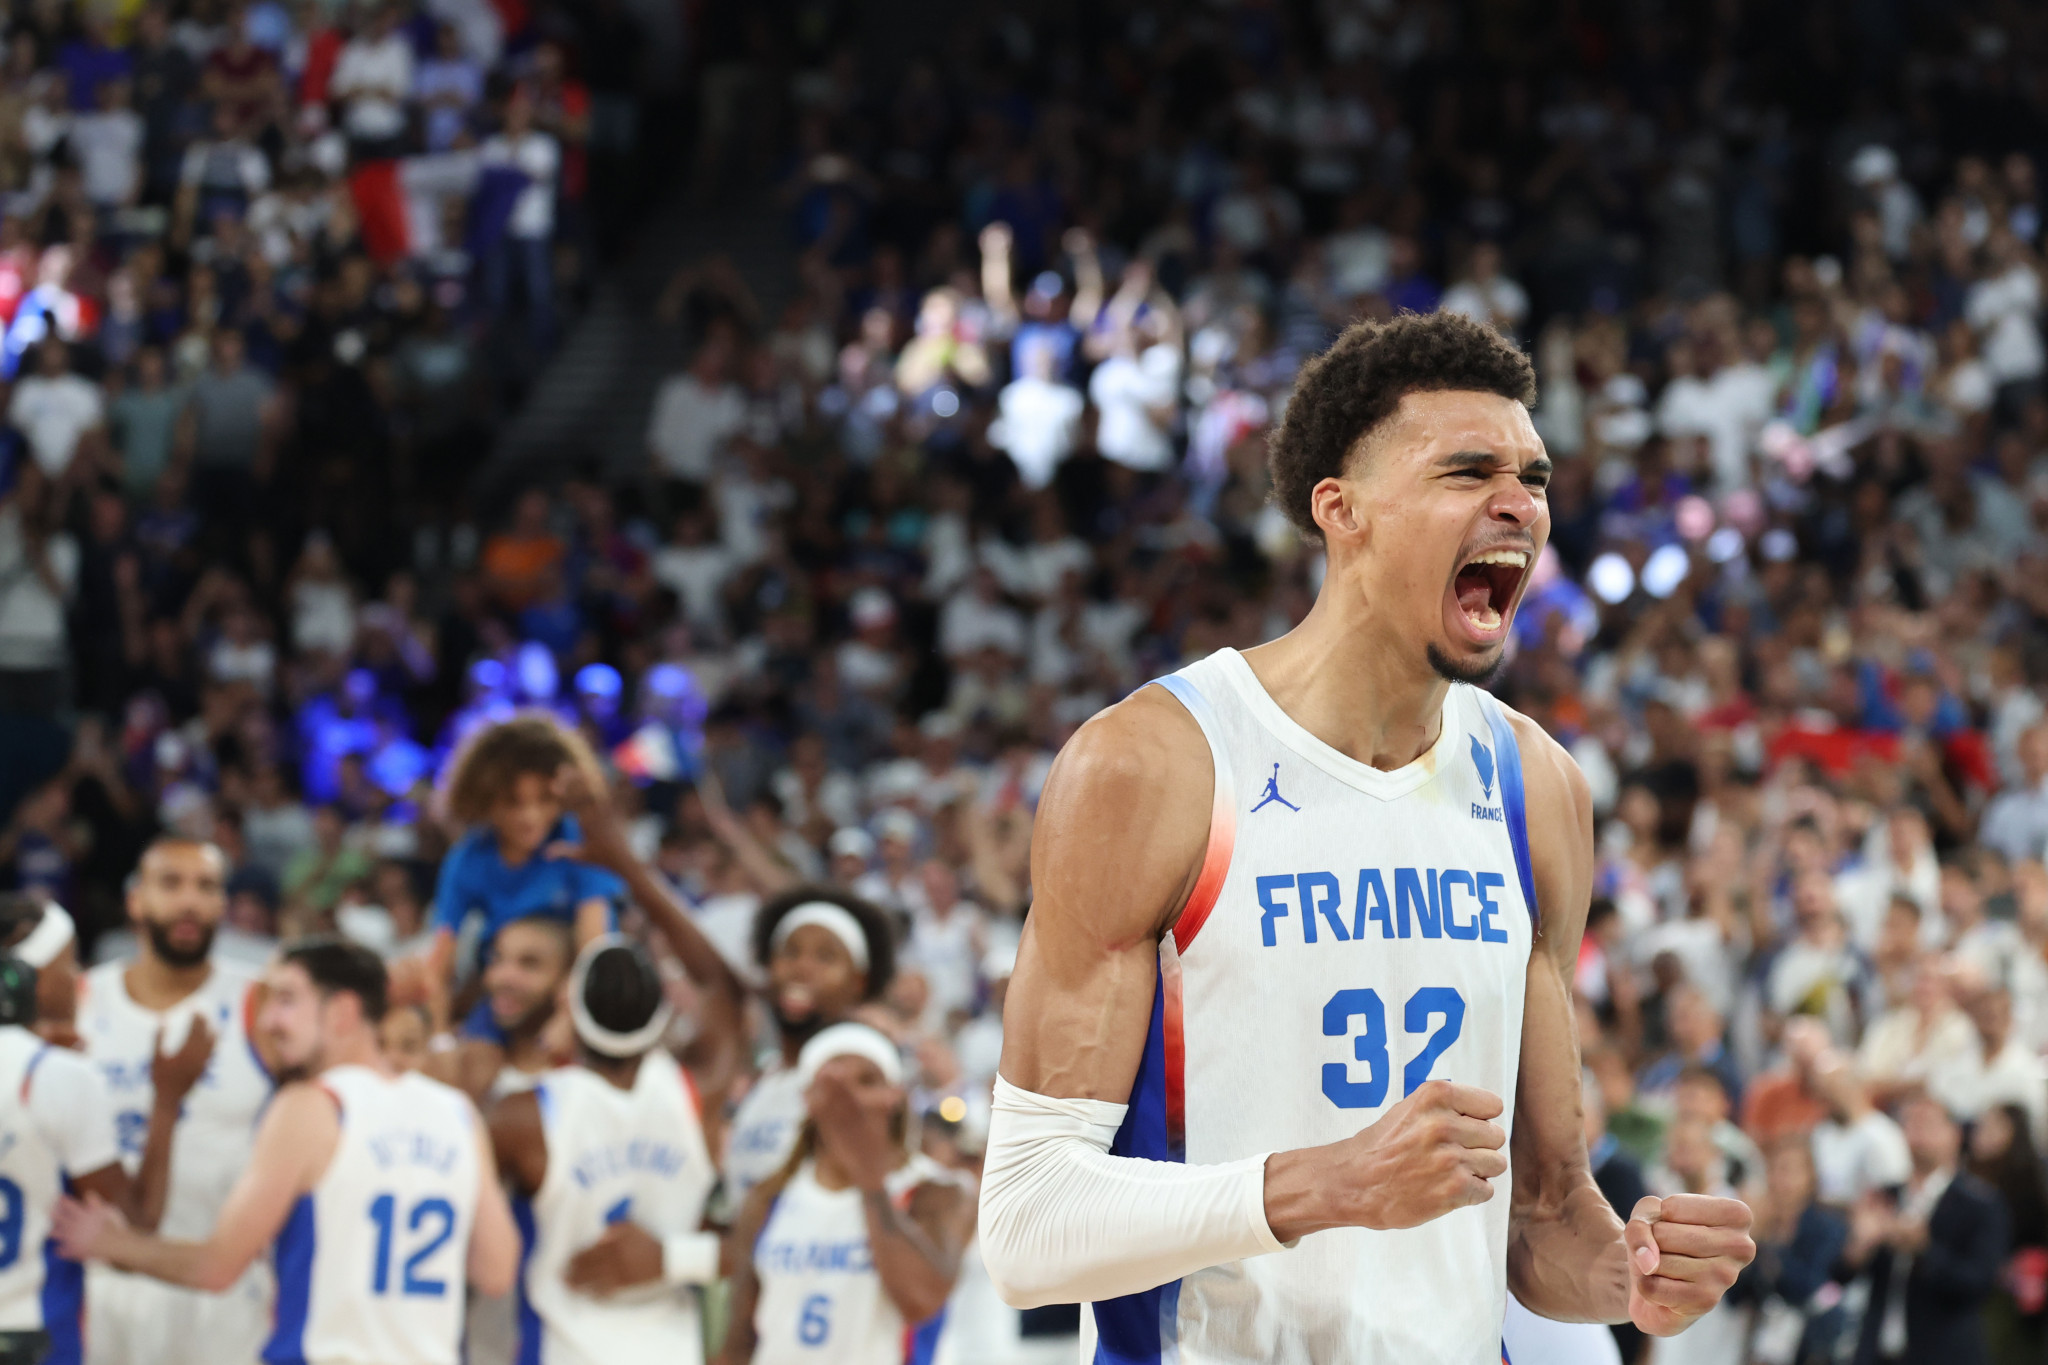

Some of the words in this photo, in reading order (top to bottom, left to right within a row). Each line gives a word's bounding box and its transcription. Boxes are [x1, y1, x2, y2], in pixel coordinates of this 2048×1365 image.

[1471, 802, 1503, 822] FRANCE
[1256, 867, 1508, 947] FRANCE
[1322, 987, 1466, 1109] 32
[369, 1194, 456, 1296] 12
[799, 1293, 831, 1346] 6
